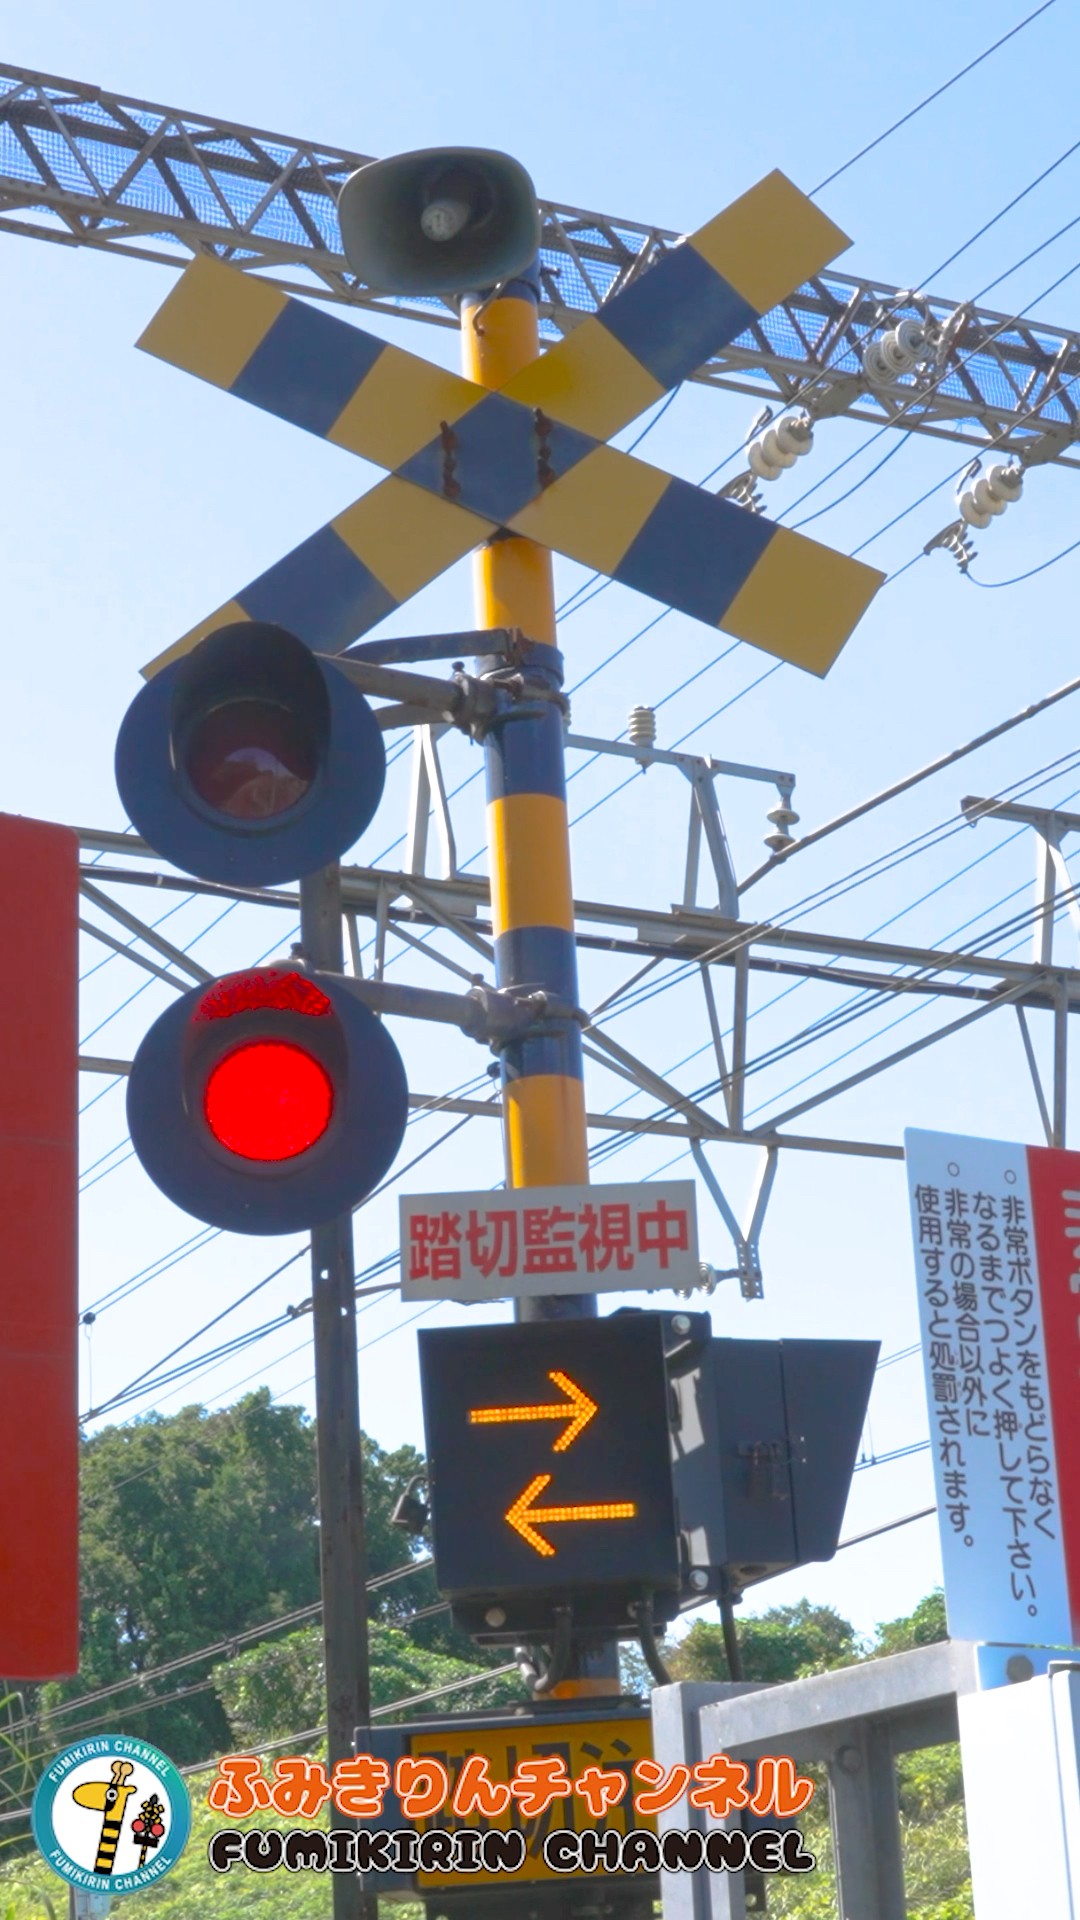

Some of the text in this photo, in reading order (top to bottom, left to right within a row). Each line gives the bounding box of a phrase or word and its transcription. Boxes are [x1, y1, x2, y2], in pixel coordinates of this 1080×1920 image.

[409, 1199, 690, 1281] 踏切監視中
[914, 1183, 975, 1548] 使用すると処罰されます。
[944, 1187, 990, 1437] 非常の場合以外に
[972, 1191, 1038, 1618] なるまでつよく押して下さい。
[1001, 1195, 1056, 1540] 非常ボタンをもどらなく
